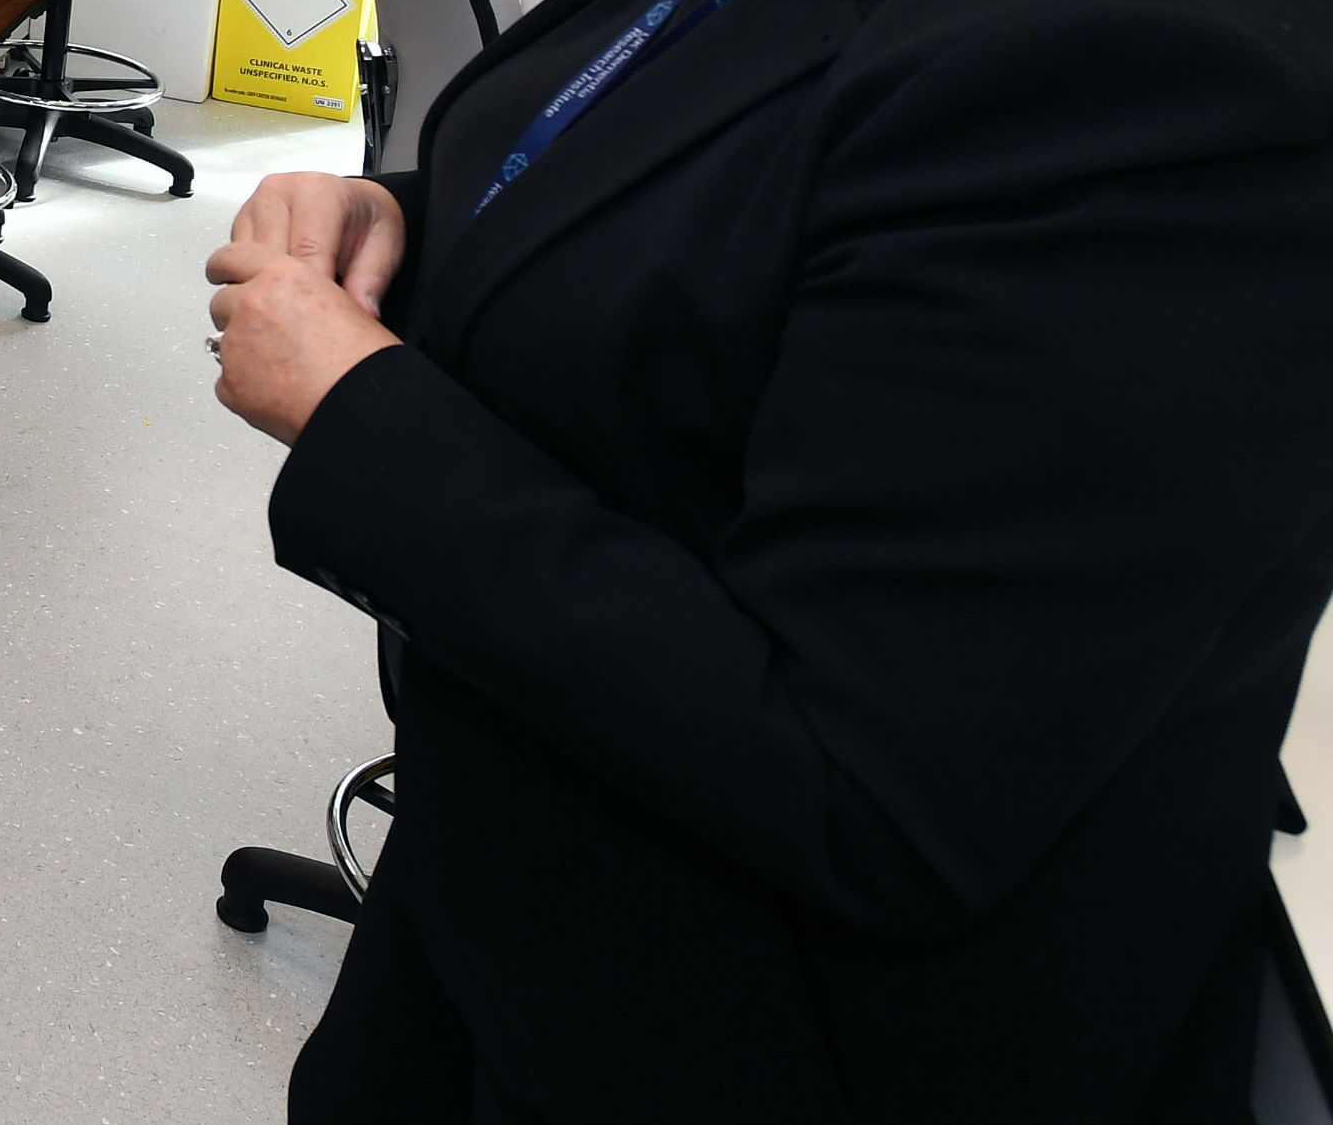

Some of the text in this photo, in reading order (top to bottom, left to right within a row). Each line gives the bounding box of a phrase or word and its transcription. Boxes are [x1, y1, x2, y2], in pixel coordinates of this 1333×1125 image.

[286, 28, 292, 36] 6
[249, 58, 323, 76] CLINICAL WASTE
[545, 27, 644, 118] Research Institute
[577, 32, 650, 98] UK Dementia
[240, 67, 329, 88] UNSPECIFIED, N.O.S.
